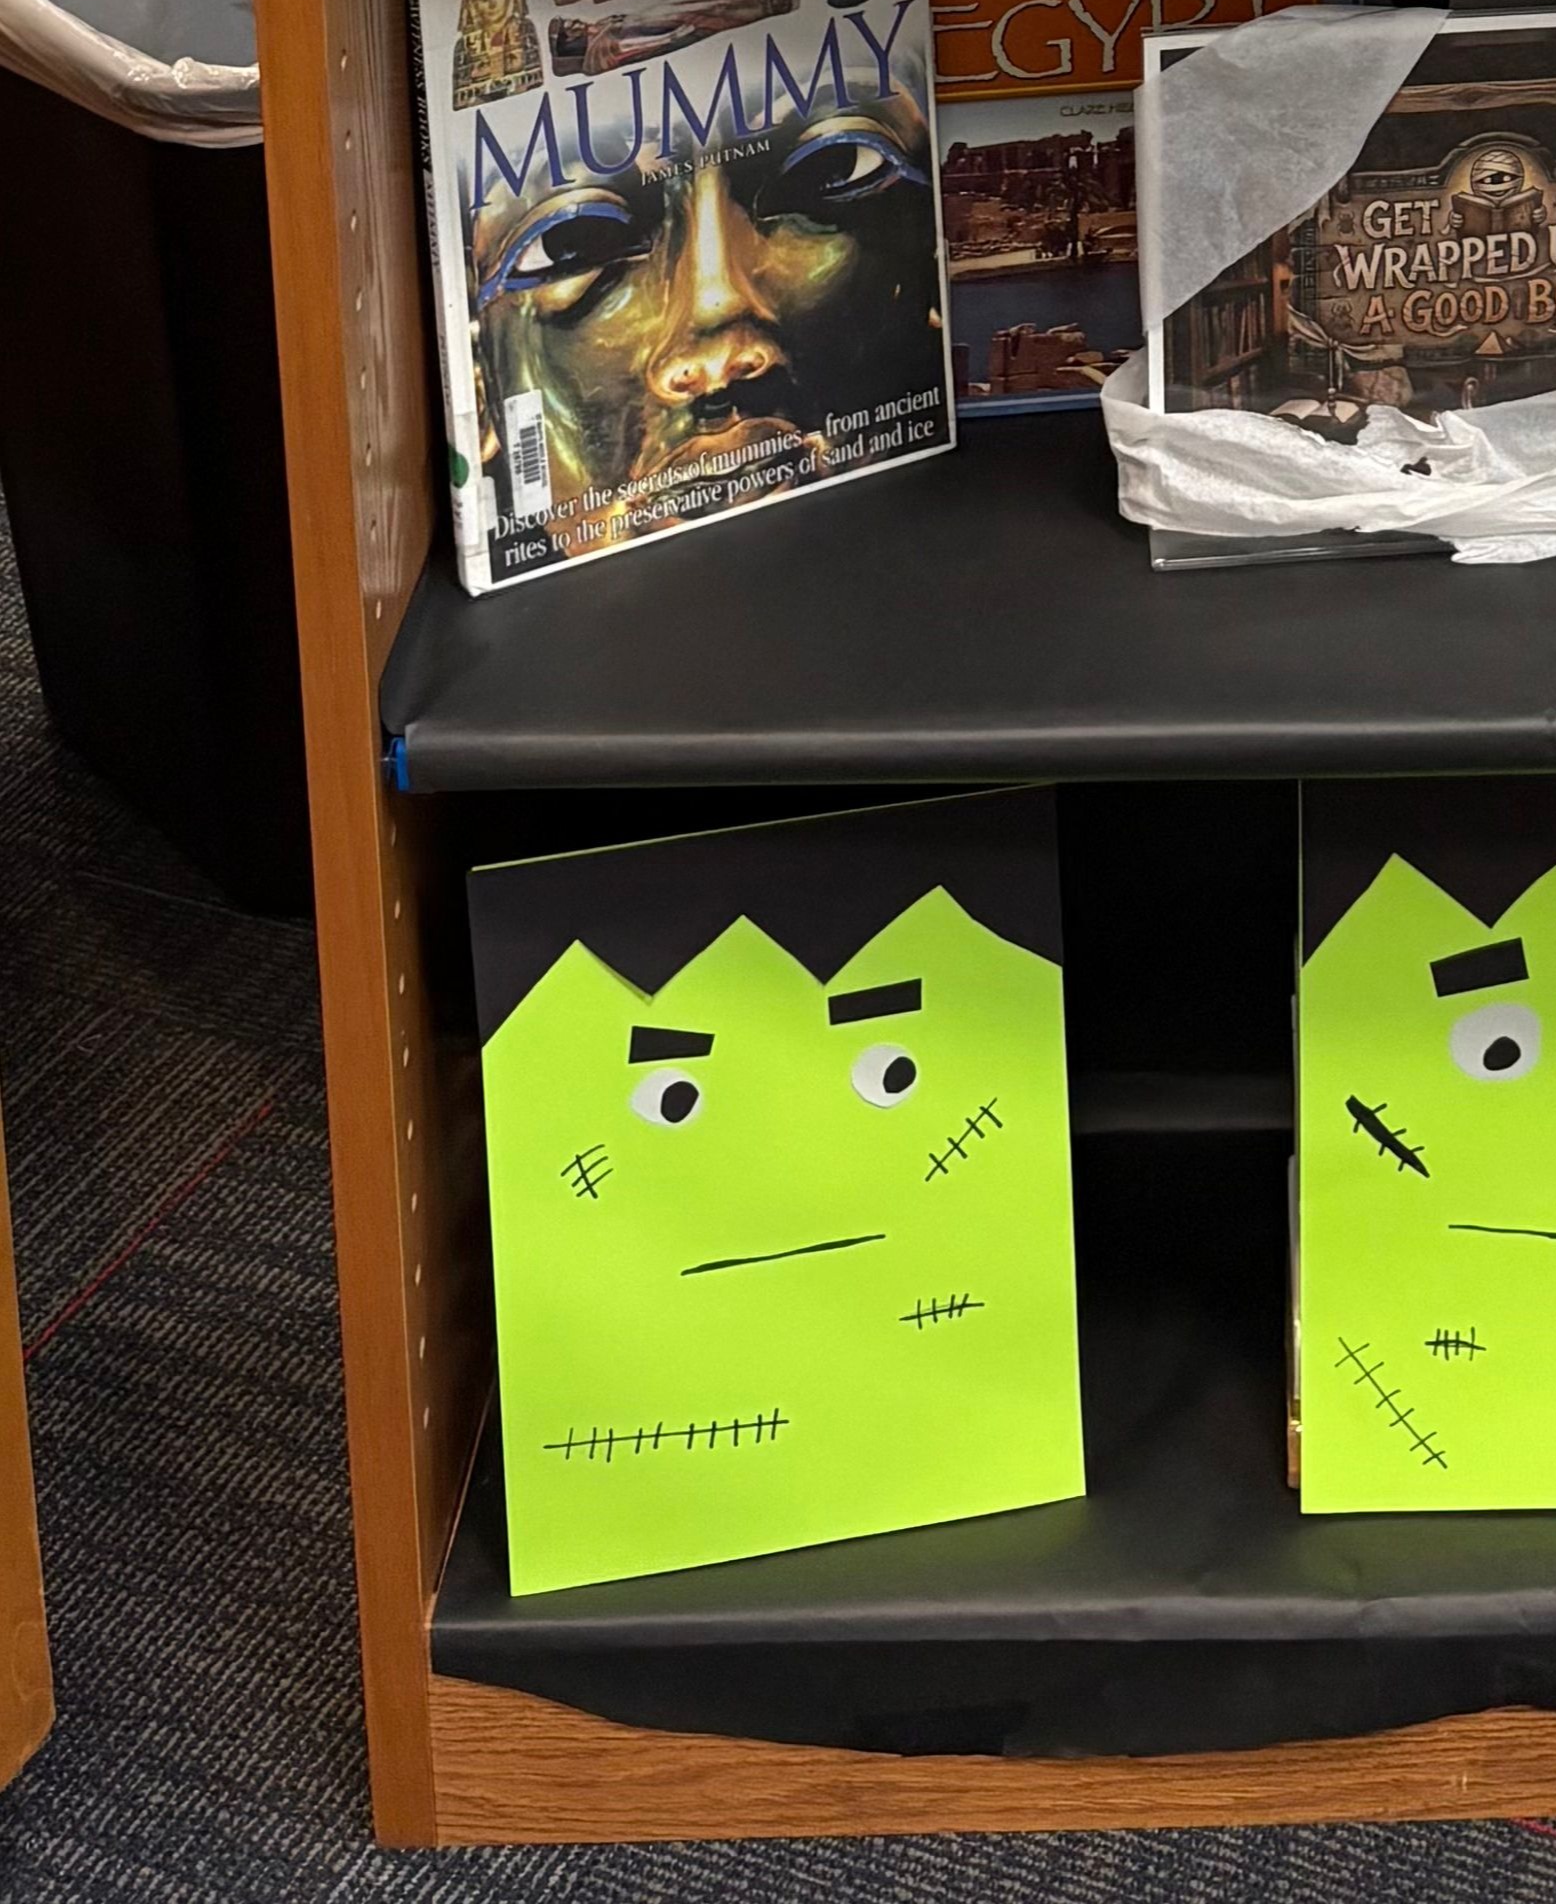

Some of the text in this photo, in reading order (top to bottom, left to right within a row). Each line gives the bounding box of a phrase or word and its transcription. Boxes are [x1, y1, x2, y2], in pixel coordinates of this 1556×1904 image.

[639, 137, 772, 187] JAMES PUTNAM
[1362, 198, 1441, 240] GET
[1334, 230, 1539, 290] WRAPPED
[1359, 295, 1395, 336] A
[1401, 286, 1510, 333] GOOD
[494, 495, 580, 542] Discover
[583, 484, 613, 512] the
[617, 467, 684, 501] secrets
[687, 459, 712, 484] of
[711, 431, 803, 474] mummies
[825, 405, 870, 439] from
[874, 385, 941, 426] ancient
[504, 417, 936, 568] rites to the preservative powers of sand and ice
